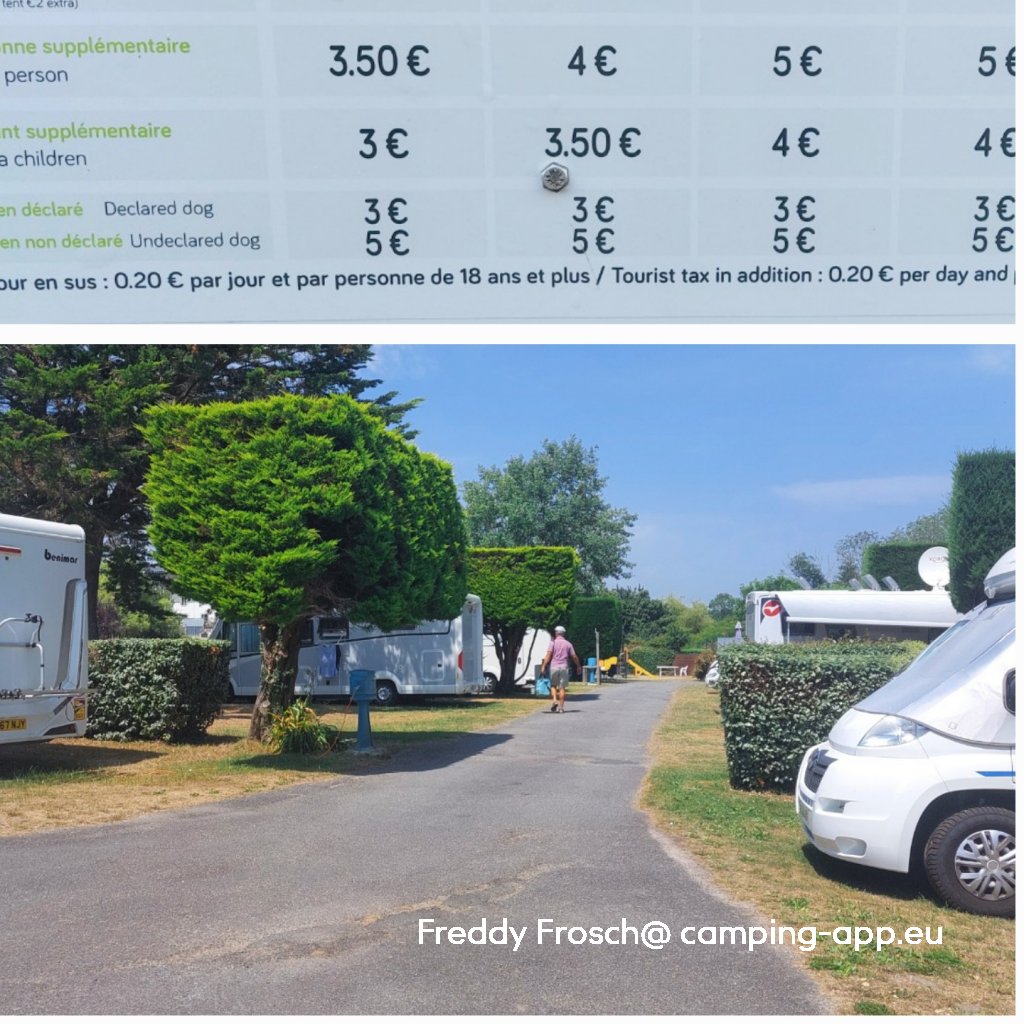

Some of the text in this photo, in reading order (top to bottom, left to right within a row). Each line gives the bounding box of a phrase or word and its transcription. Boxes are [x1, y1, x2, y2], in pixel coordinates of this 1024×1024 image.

[2, 0, 23, 8] tent
[43, 37, 190, 59] supplémentaire
[773, 45, 822, 76] 5 €
[5, 70, 68, 86] person
[545, 127, 641, 157] 3.50 €
[104, 200, 214, 218] Declared dog
[131, 232, 260, 250] Undeclared dog
[44, 549, 78, 563] benimar
